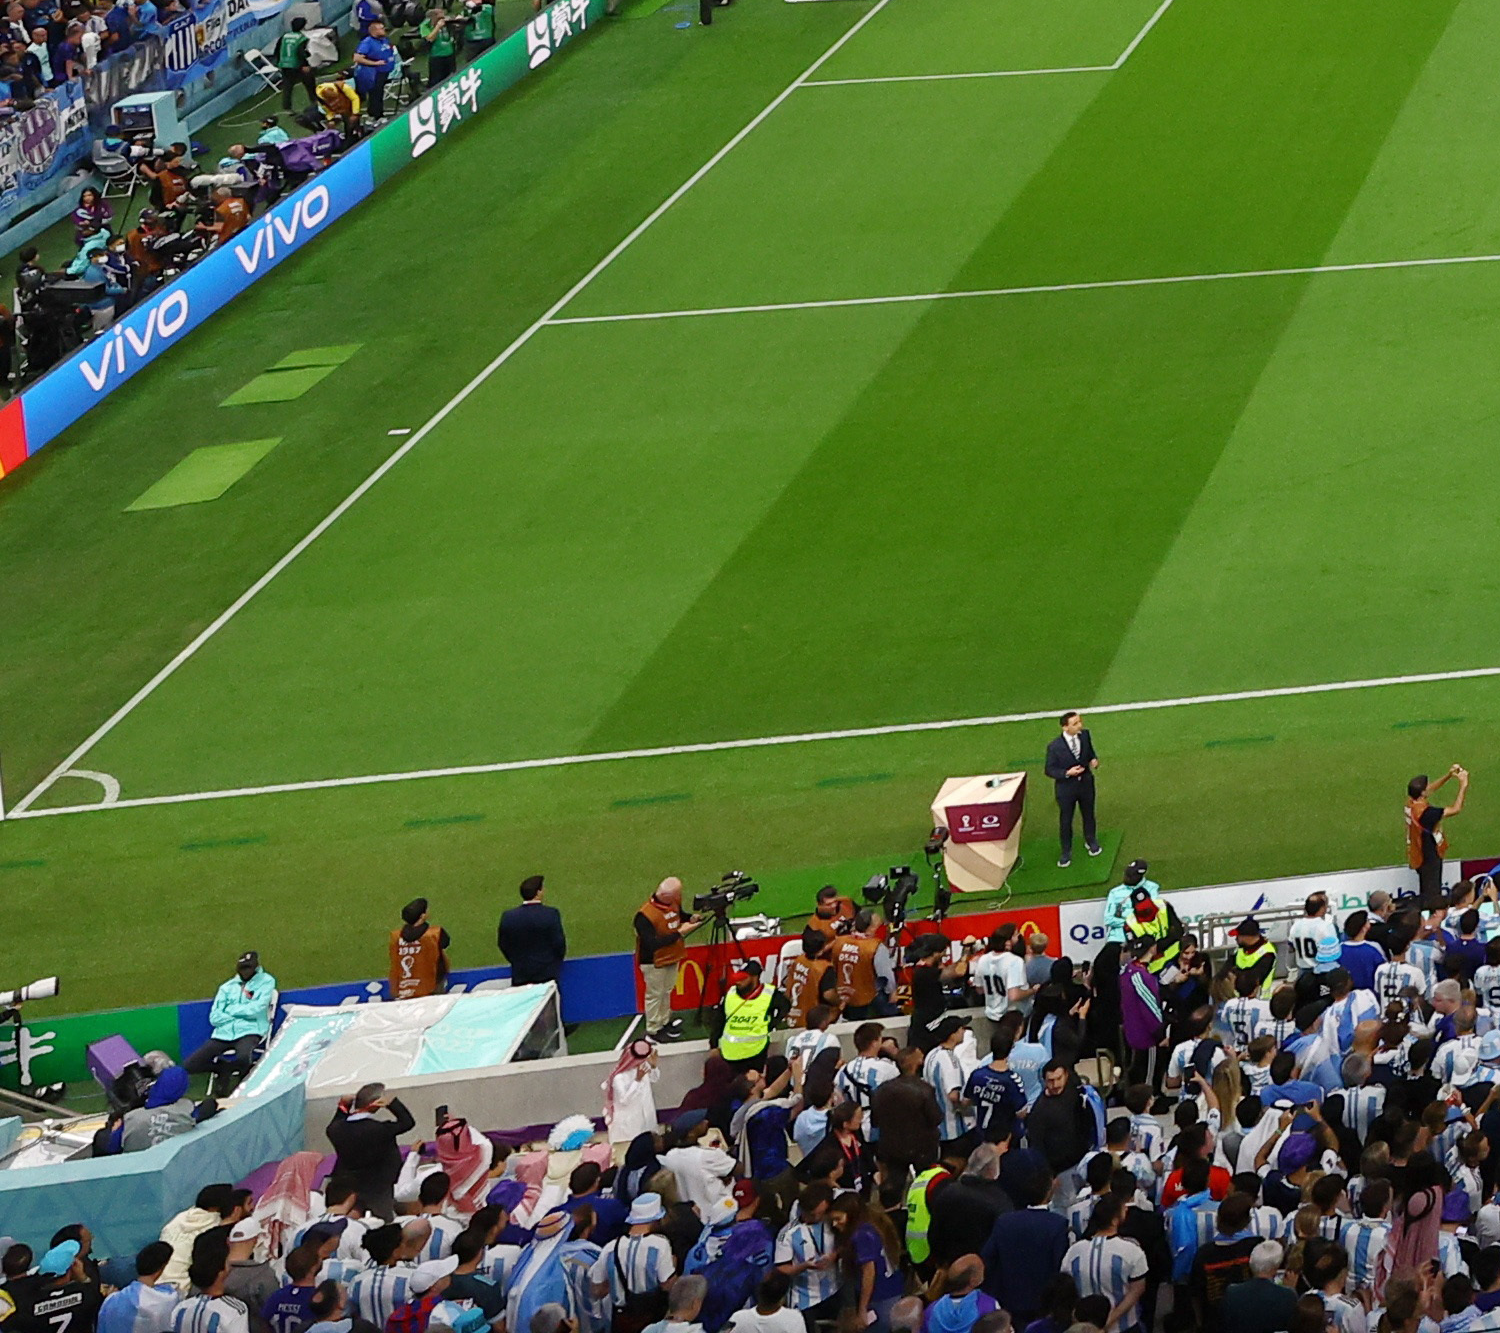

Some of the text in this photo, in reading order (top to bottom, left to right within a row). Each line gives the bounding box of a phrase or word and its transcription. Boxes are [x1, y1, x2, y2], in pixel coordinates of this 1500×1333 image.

[436, 67, 482, 134] 蒙牛
[234, 184, 329, 274] vivo
[79, 288, 189, 392] vivo
[1294, 937, 1318, 960] 10
[984, 975, 1007, 997] 10
[981, 1101, 994, 1129] 7
[49, 1312, 73, 1333] 7
